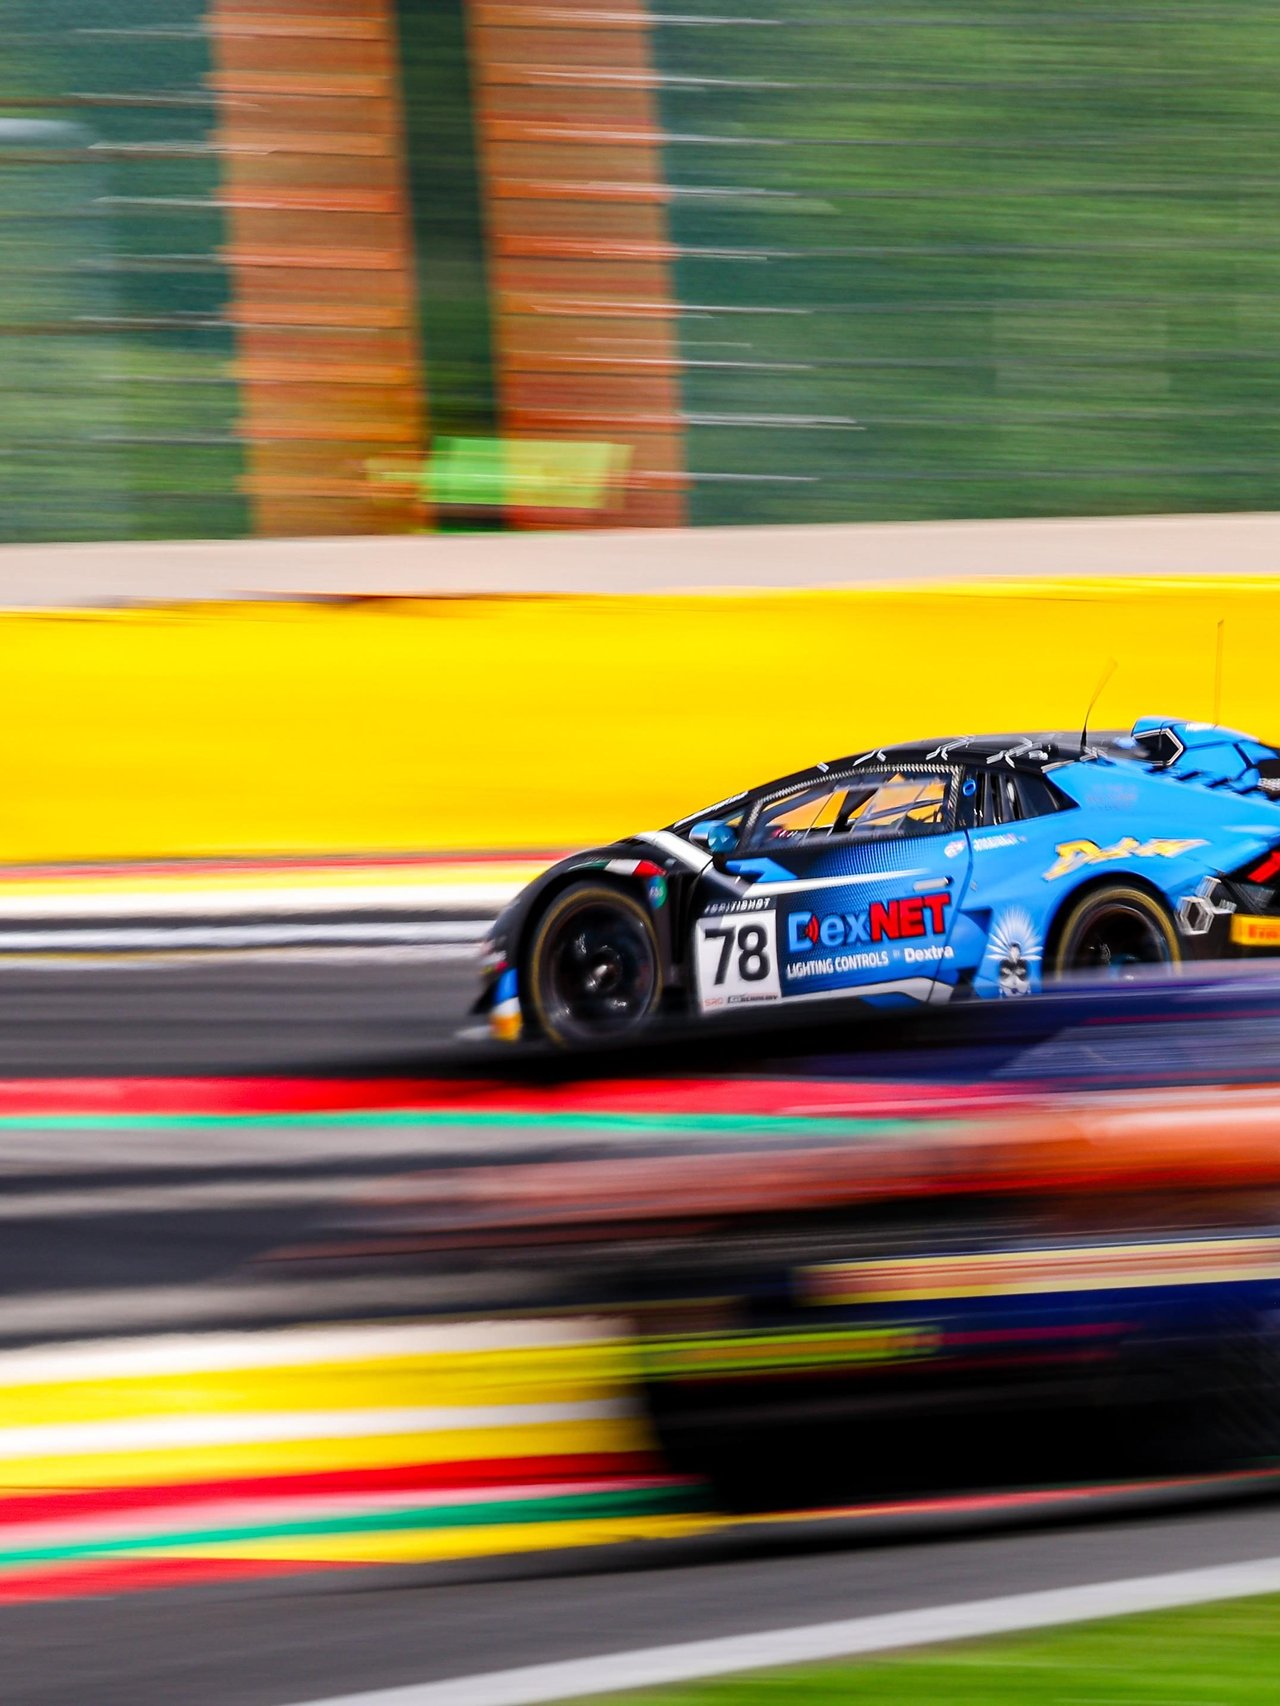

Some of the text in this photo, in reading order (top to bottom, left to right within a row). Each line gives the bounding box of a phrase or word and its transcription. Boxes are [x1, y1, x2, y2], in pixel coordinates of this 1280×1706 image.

[788, 893, 950, 952] DexNET
[704, 924, 770, 986] 78
[787, 957, 833, 979] LIGHTING
[834, 951, 889, 972] CONTROLS
[904, 945, 955, 964] Dextra
